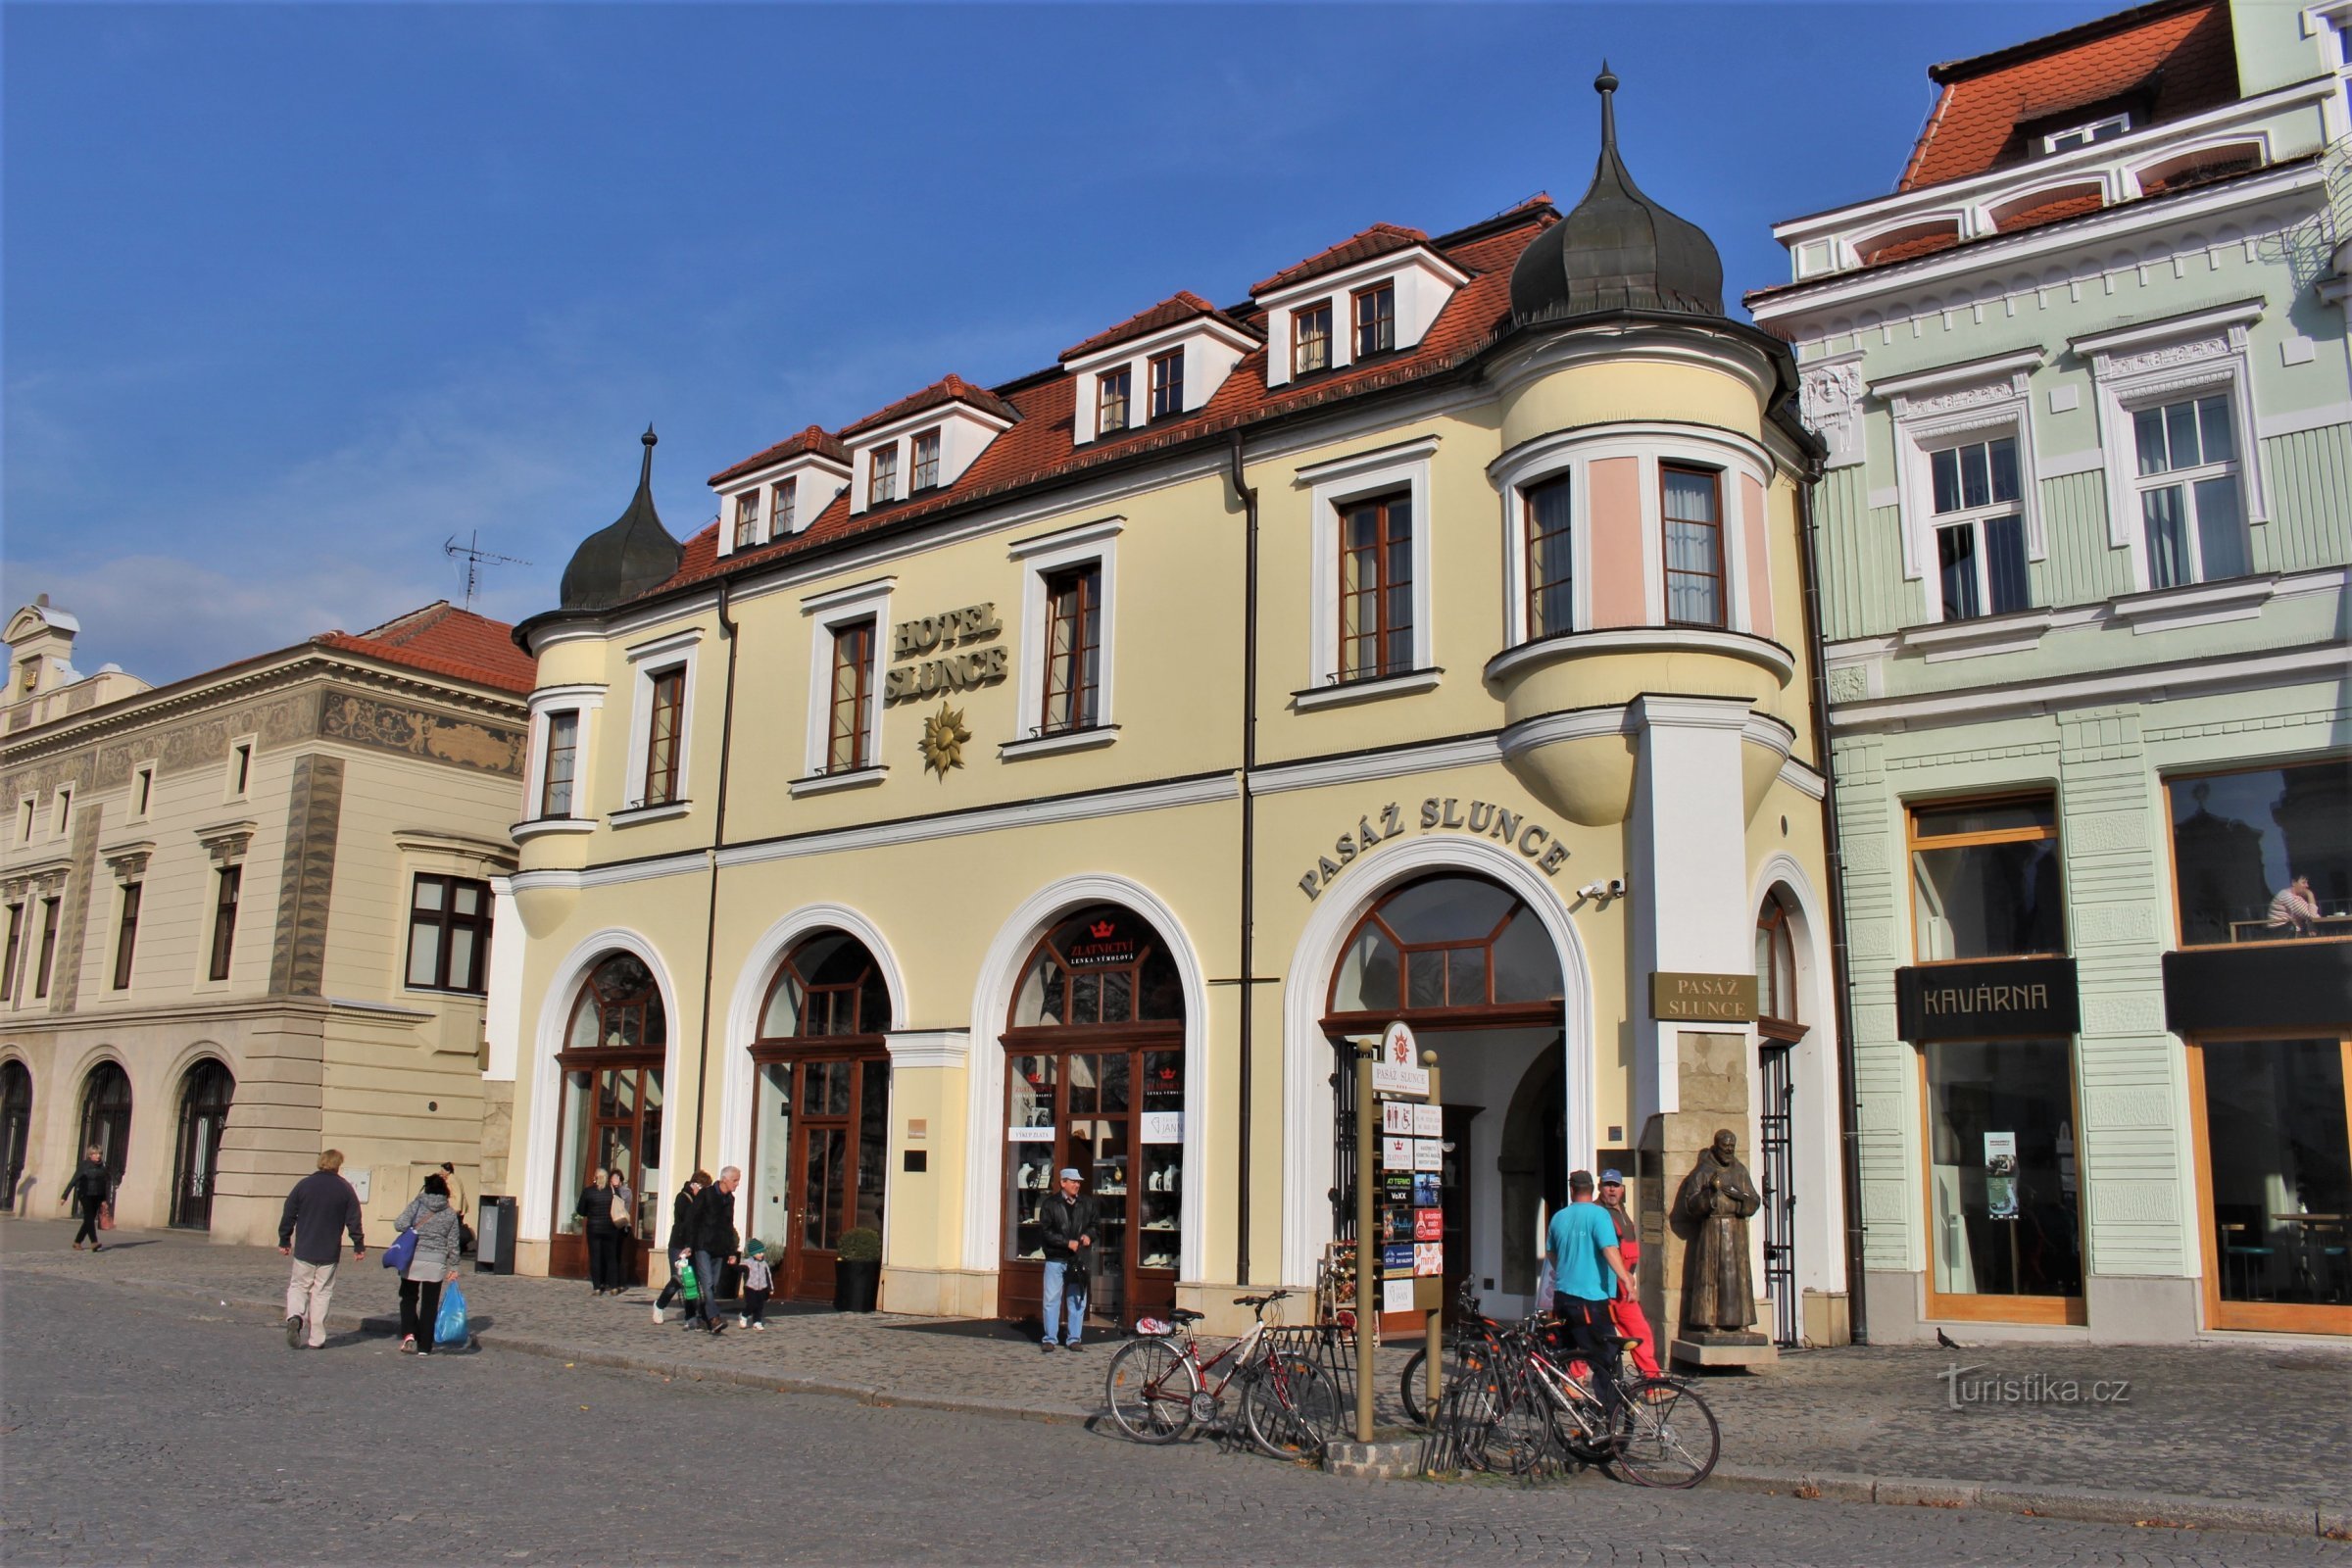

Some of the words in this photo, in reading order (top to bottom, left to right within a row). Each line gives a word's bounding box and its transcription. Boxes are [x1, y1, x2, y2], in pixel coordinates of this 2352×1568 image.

[894, 602, 1004, 655] HOTEL
[884, 645, 1008, 702] SLUNCE
[1298, 802, 1405, 902] PASÁŽ
[1420, 797, 1571, 876] SLUNCE
[1070, 938, 1134, 956] ZLATNICTVÍ
[1097, 952, 1134, 962] VÝMOLOVÁ
[1677, 977, 1739, 996] PASÁŽ
[1669, 1000, 1746, 1016] SLUNCE
[1924, 983, 2048, 1015] KAVÁRNA
[1376, 1068, 1397, 1081] PASÁŽ
[1400, 1072, 1426, 1085] SLUNCE
